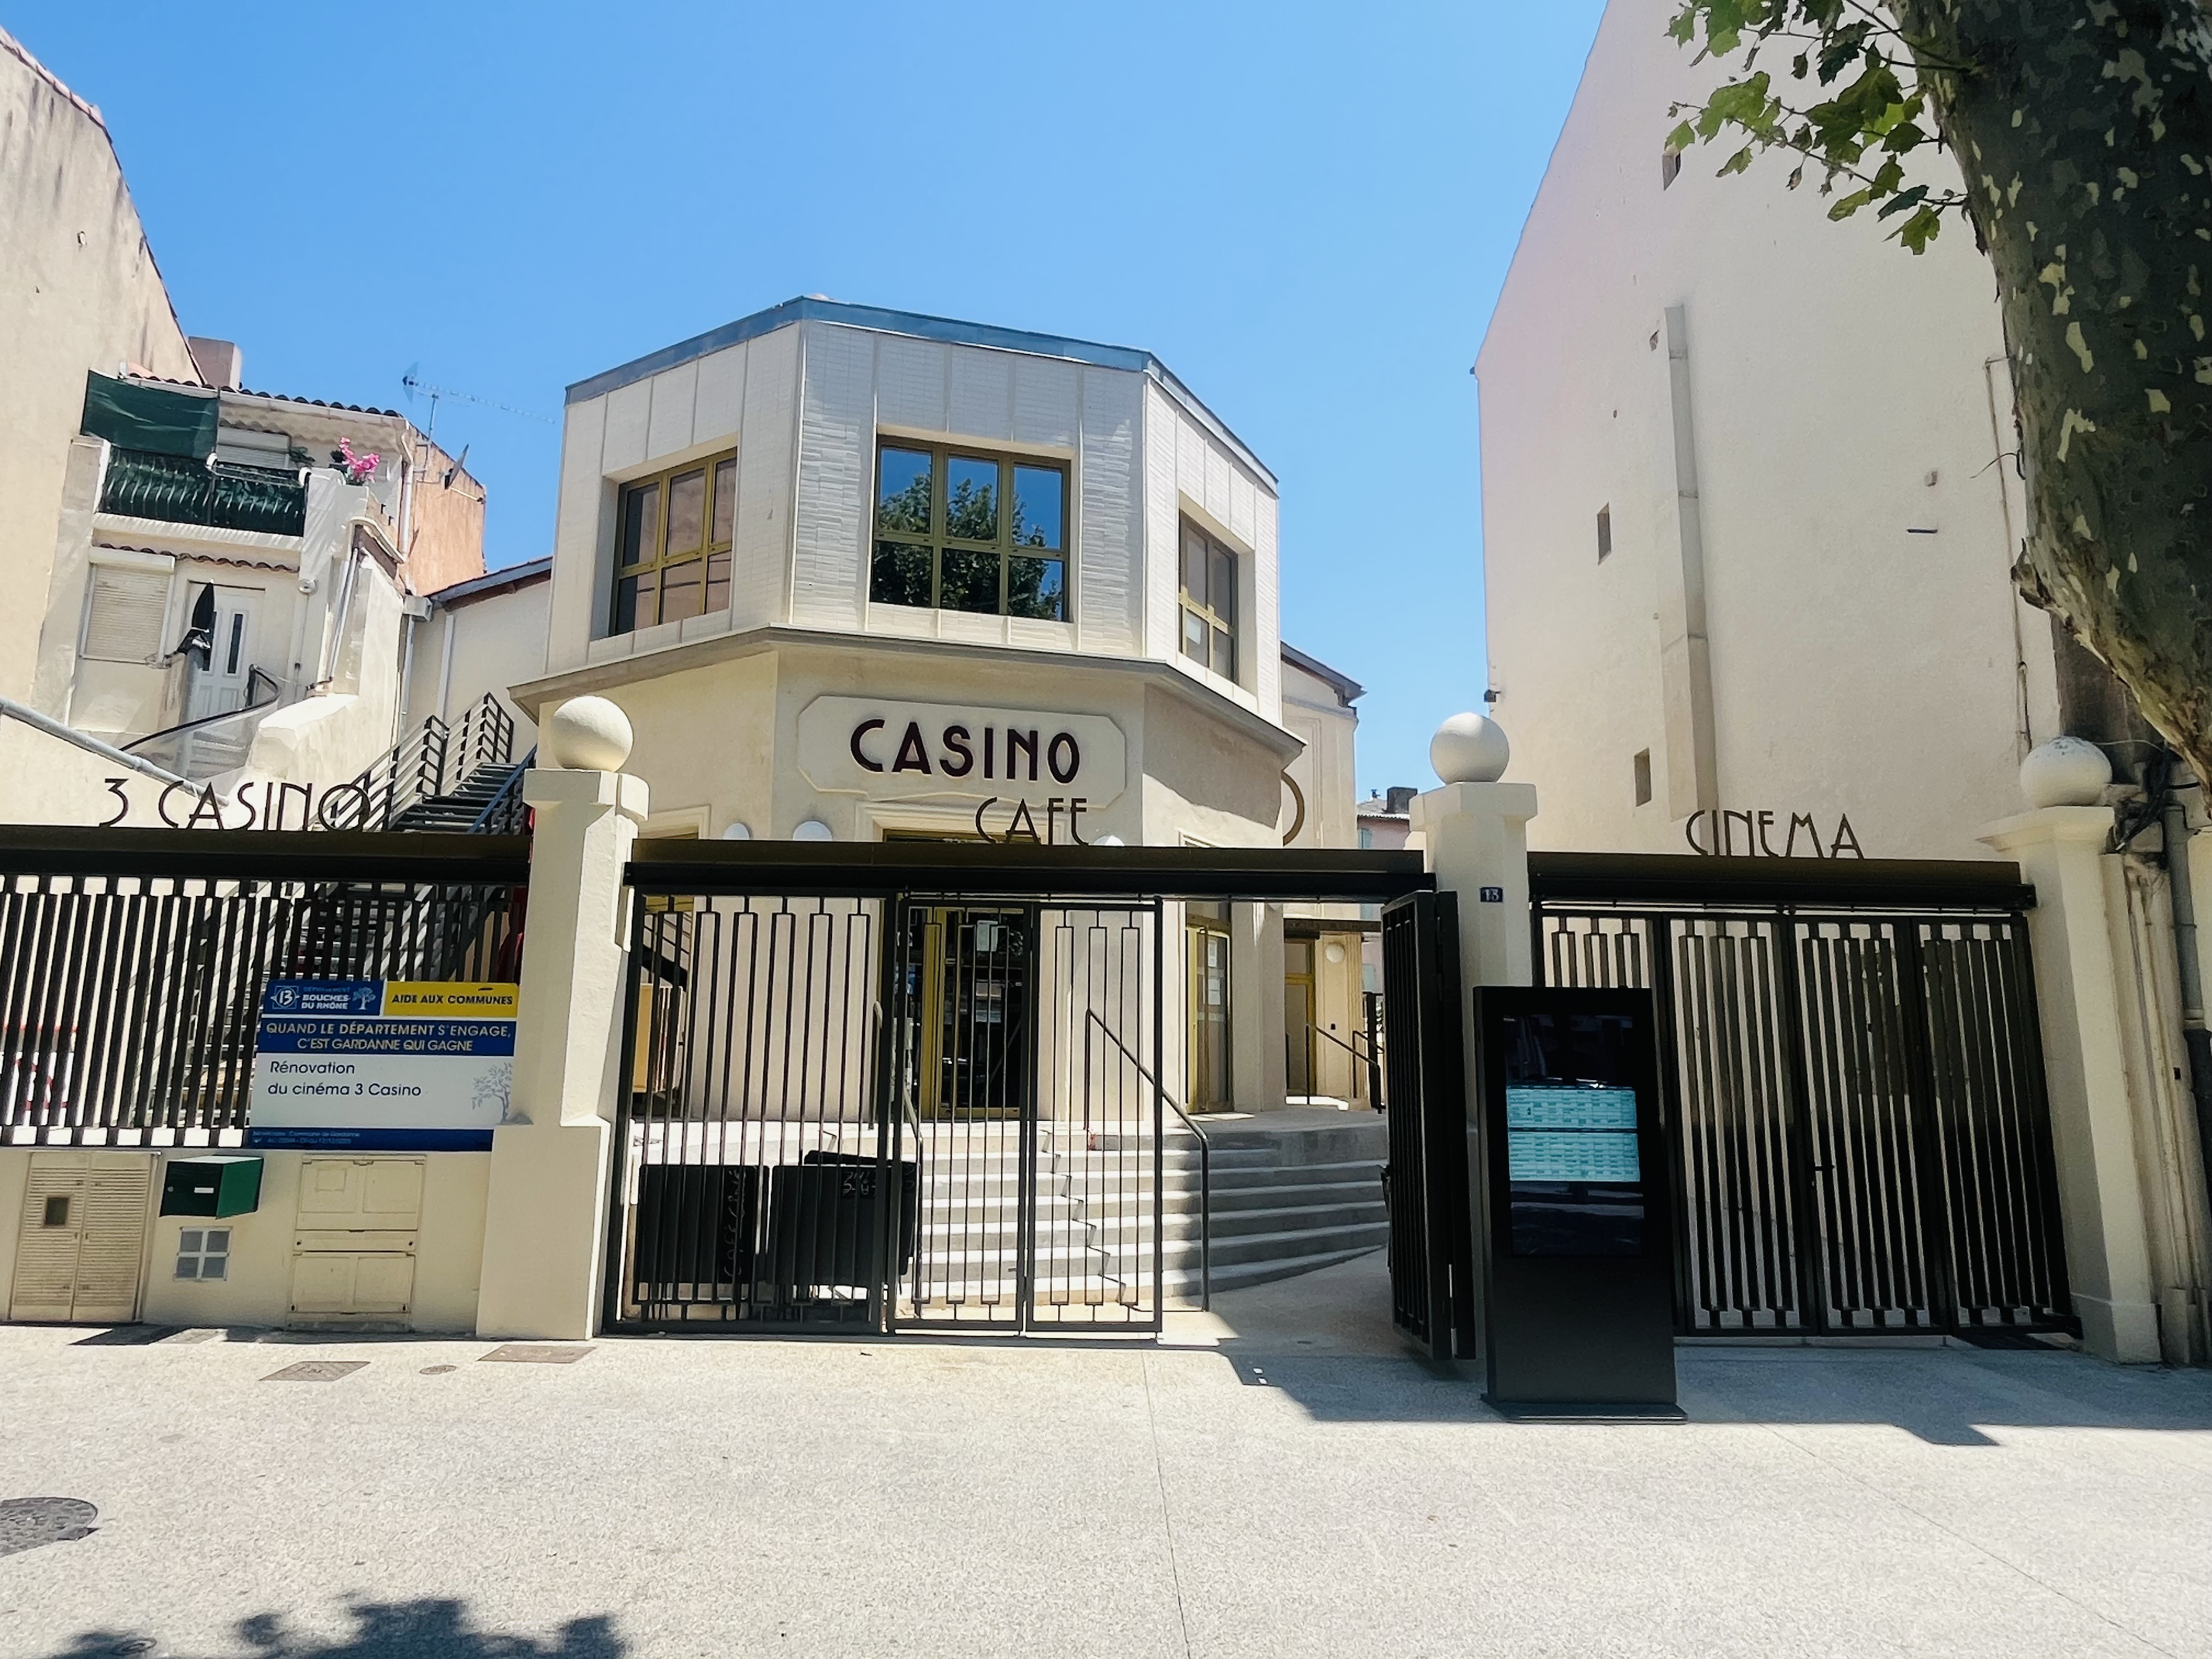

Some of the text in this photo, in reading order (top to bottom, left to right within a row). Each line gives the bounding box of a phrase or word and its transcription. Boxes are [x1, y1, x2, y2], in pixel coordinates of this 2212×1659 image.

[850, 718, 1080, 785] CASINO
[99, 777, 371, 833] 3 CASINO
[975, 795, 1091, 847] CAFE
[1685, 809, 1865, 860] CINEMA
[1485, 888, 1499, 901] 13
[279, 990, 293, 1005] 13
[391, 994, 513, 1005] AIDE AUX COMMUNES
[266, 1023, 317, 1034] QUAND
[320, 1023, 335, 1035] LE
[339, 1021, 435, 1036] DÉPARTEMENT
[297, 1038, 473, 1052] C'EST GARDANNE QUI GAGNE
[270, 1060, 356, 1074] Rénovation
[268, 1082, 422, 1096] du cinéma 3 Casino
